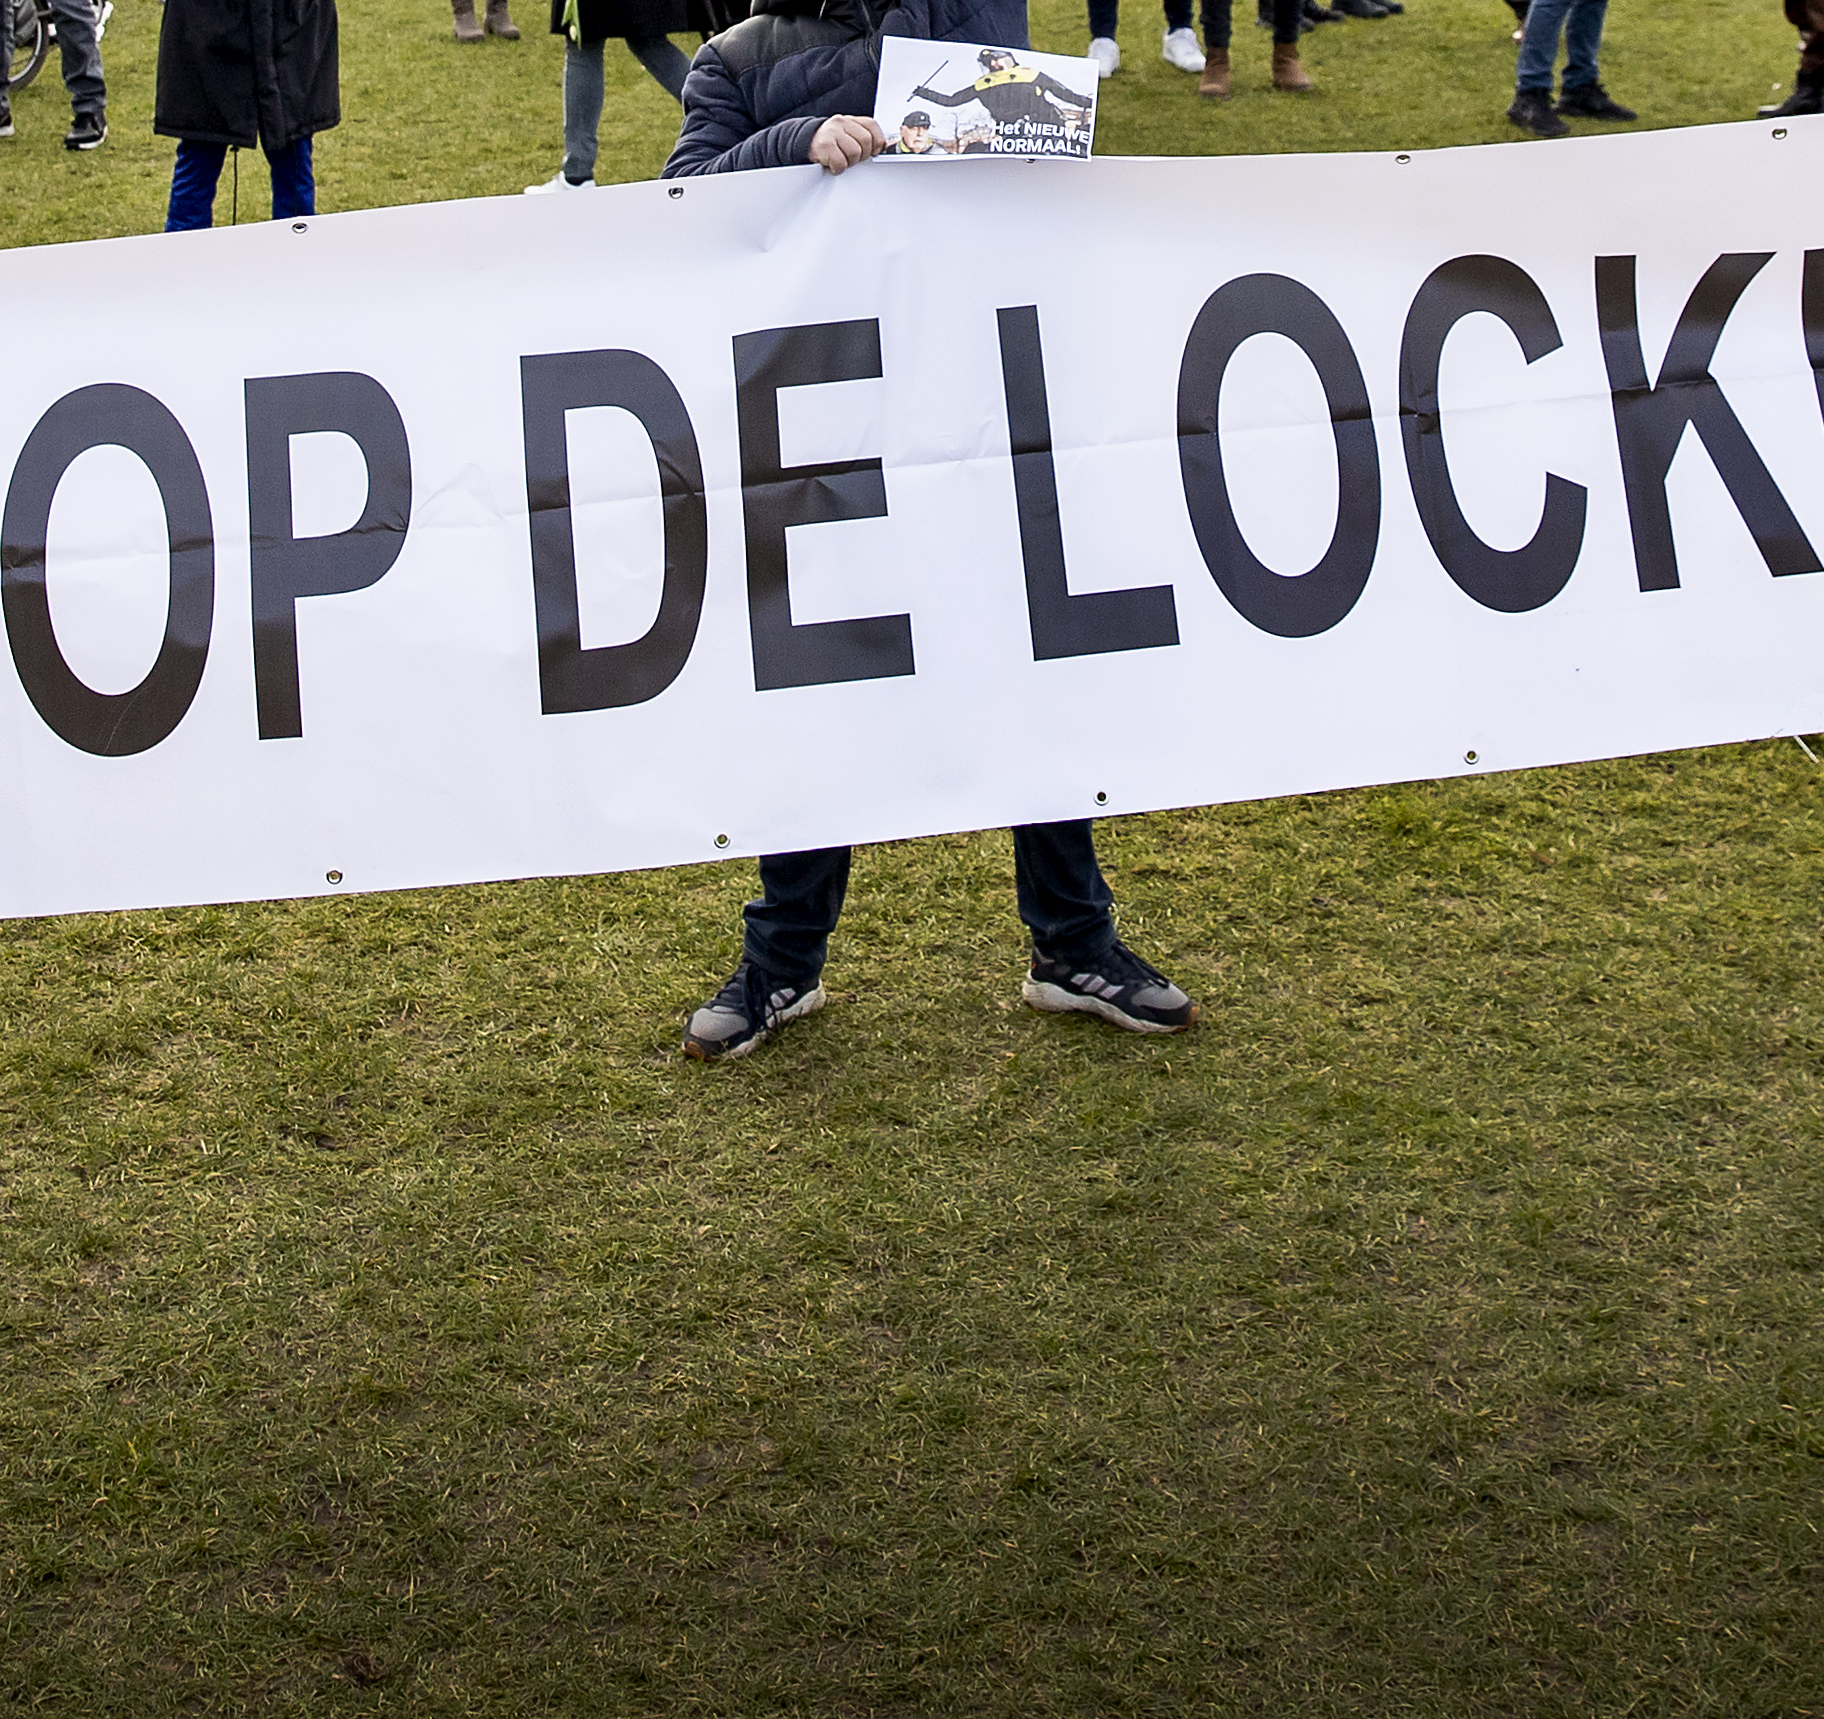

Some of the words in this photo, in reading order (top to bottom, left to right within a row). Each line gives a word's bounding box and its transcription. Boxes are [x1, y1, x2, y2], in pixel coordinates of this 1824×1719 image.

[991, 120, 1021, 135] Het
[1023, 121, 1090, 144] NIEUWE
[989, 138, 1081, 155] NORMAAL!
[520, 318, 915, 715] DE
